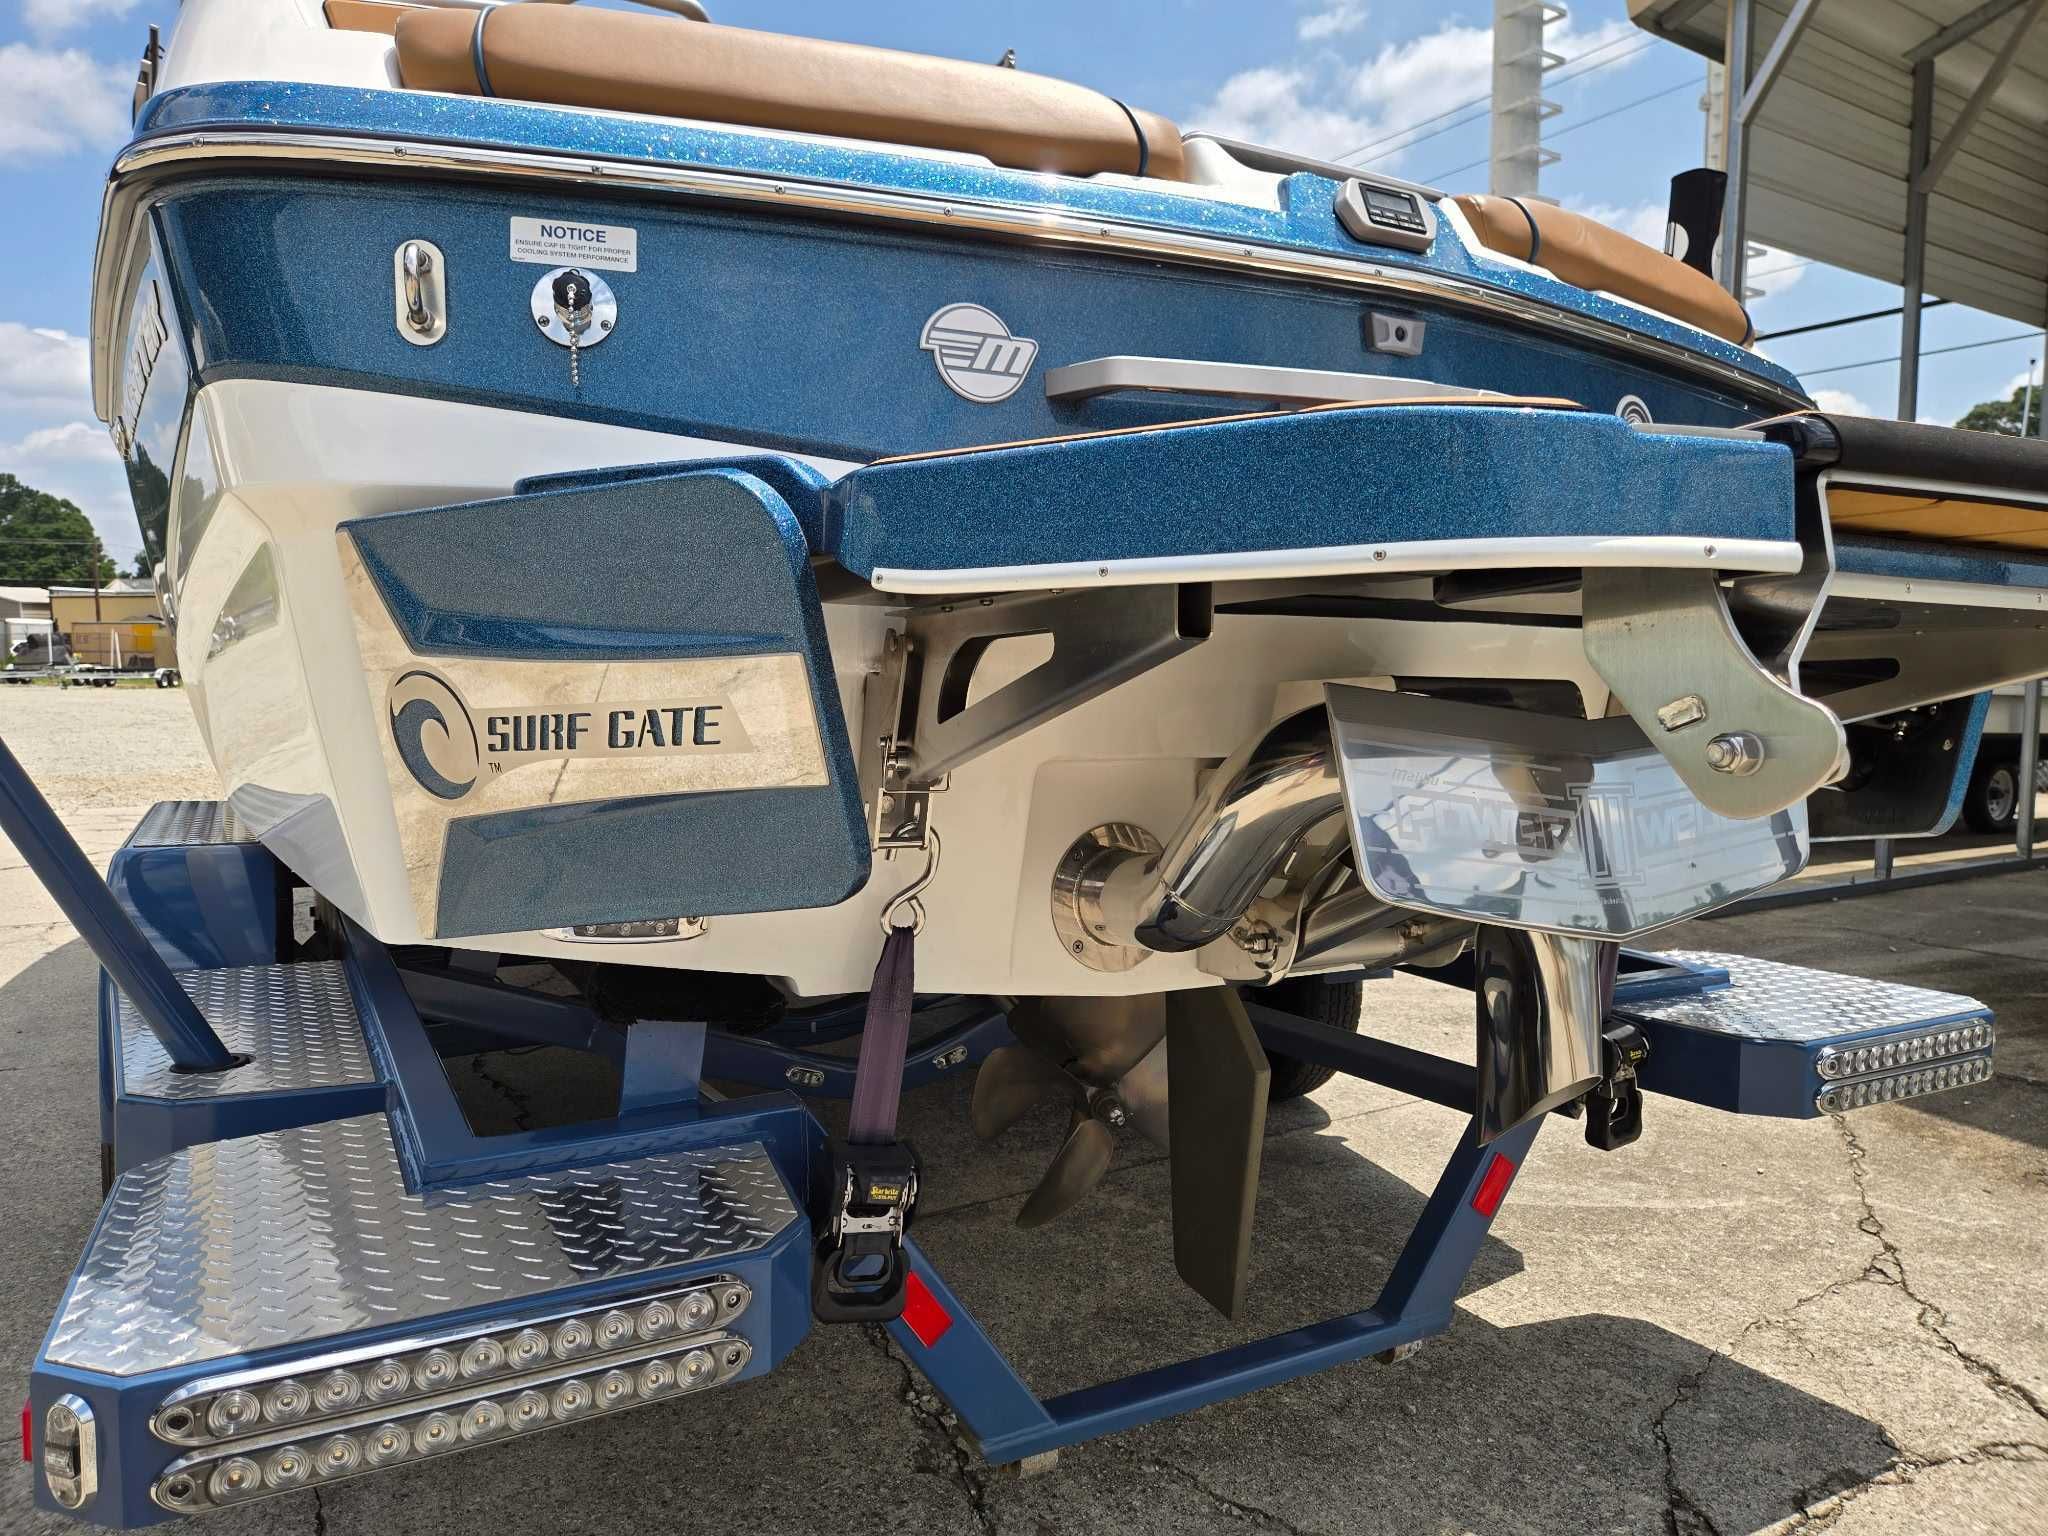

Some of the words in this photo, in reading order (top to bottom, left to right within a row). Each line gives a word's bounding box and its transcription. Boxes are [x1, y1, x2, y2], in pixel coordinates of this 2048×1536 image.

[541, 224, 607, 243] NOTICE
[515, 238, 542, 247] ENSURE
[543, 241, 557, 249] CAP
[568, 243, 587, 251] TIGHT
[588, 245, 602, 253] FOR
[603, 247, 631, 256] PROPER
[517, 247, 548, 256] COOLING
[549, 250, 577, 259] SYSTEM
[578, 252, 629, 264] PERFORMANCE
[487, 712, 592, 752] SURF
[608, 705, 723, 749] GATE
